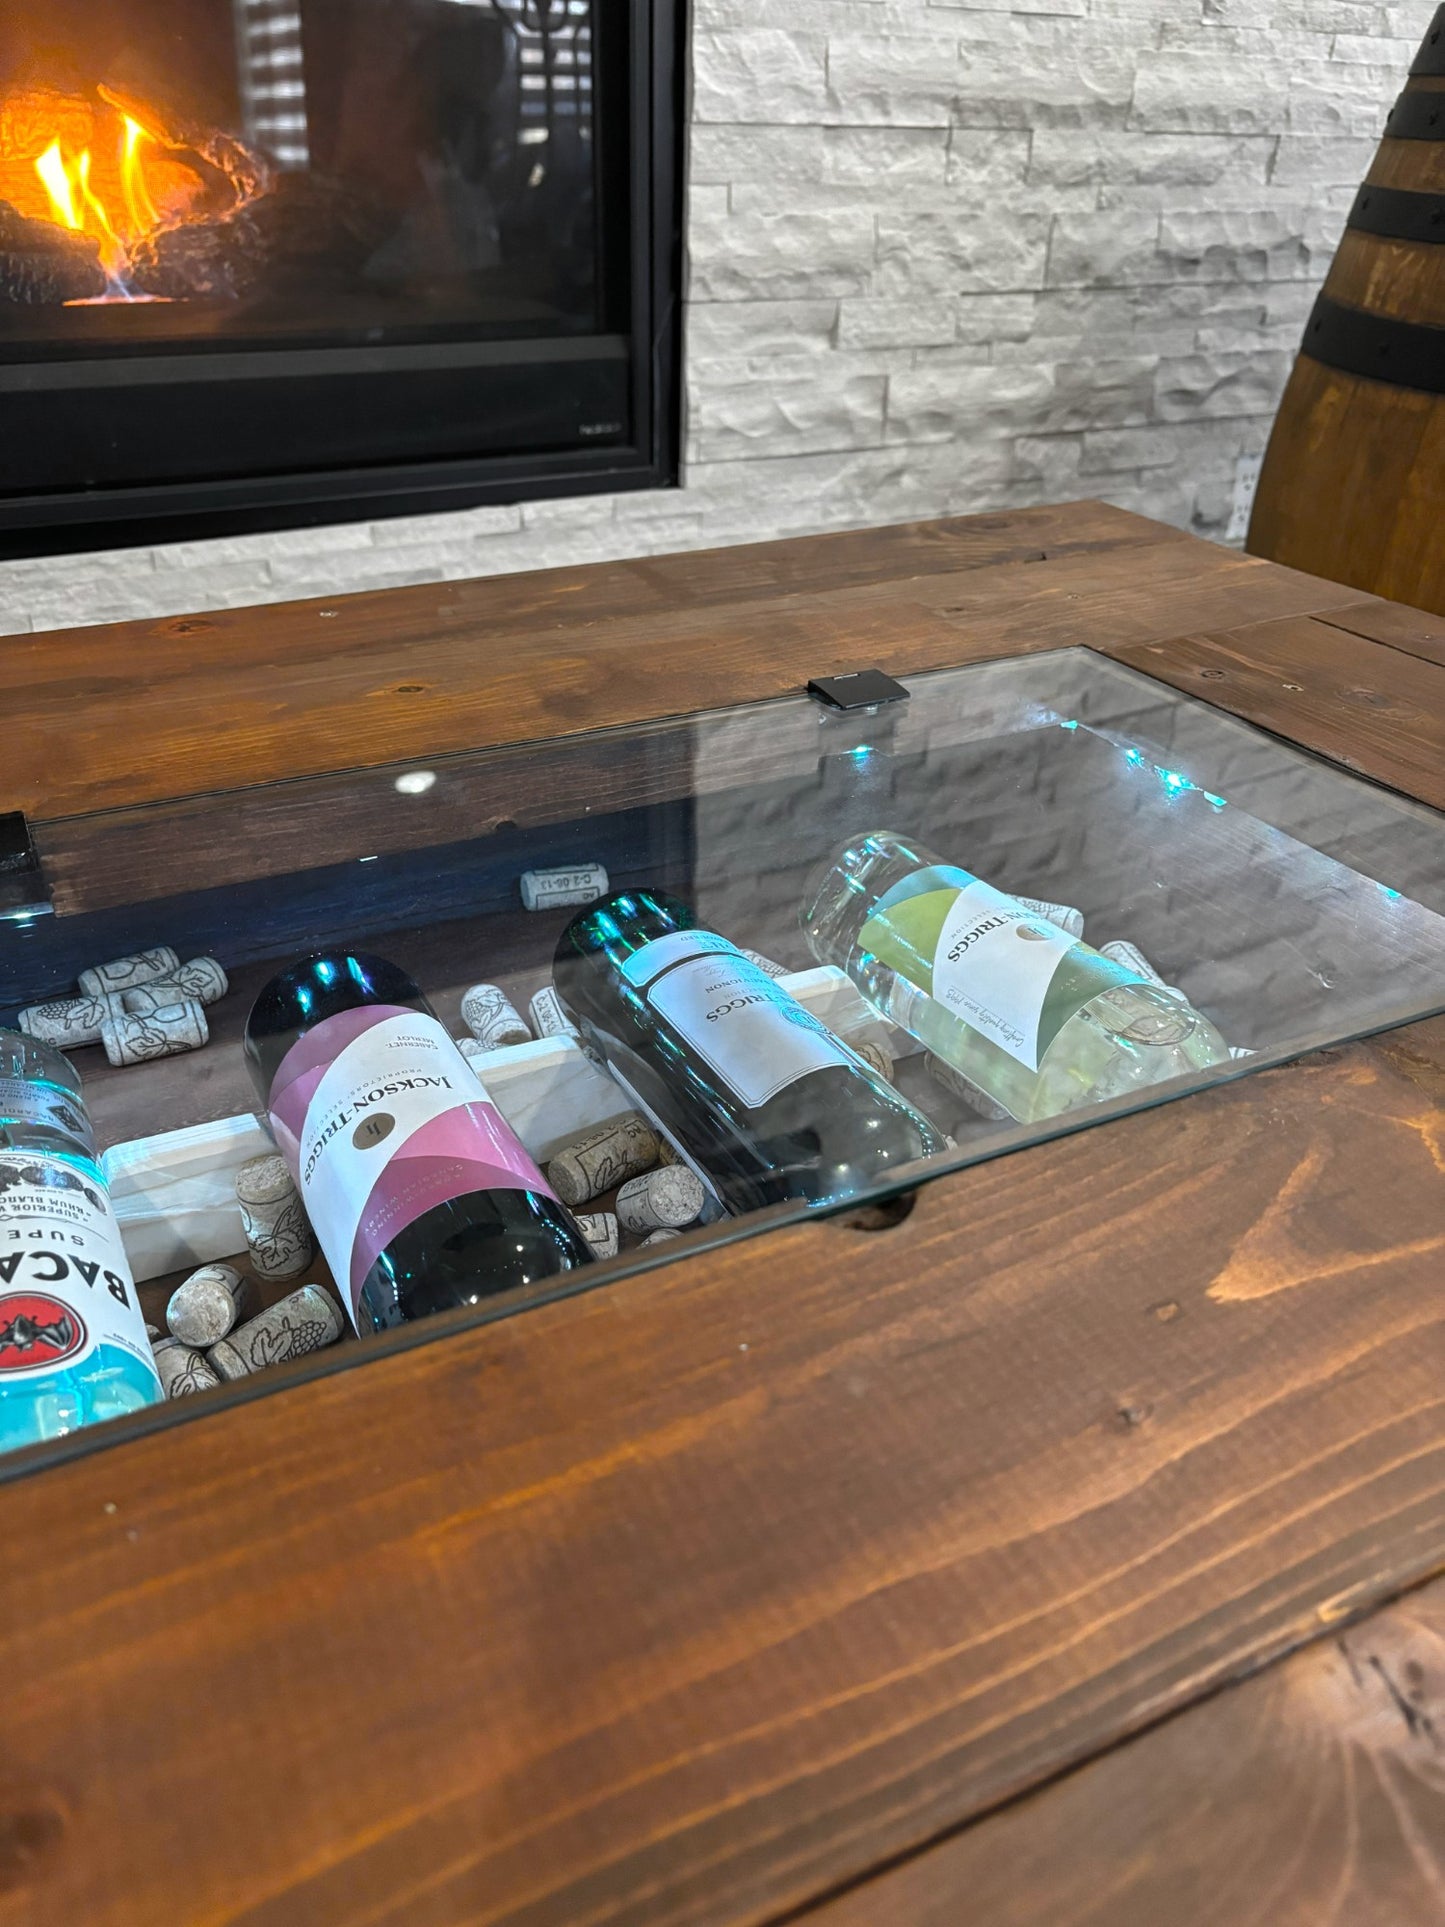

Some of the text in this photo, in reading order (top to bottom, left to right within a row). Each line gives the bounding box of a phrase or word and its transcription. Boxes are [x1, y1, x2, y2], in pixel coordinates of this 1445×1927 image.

[303, 1075, 454, 1186] JACKSON-TRIGGS
[11, 1203, 80, 1220] SUPERIOR
[49, 1199, 84, 1215] RHUM
